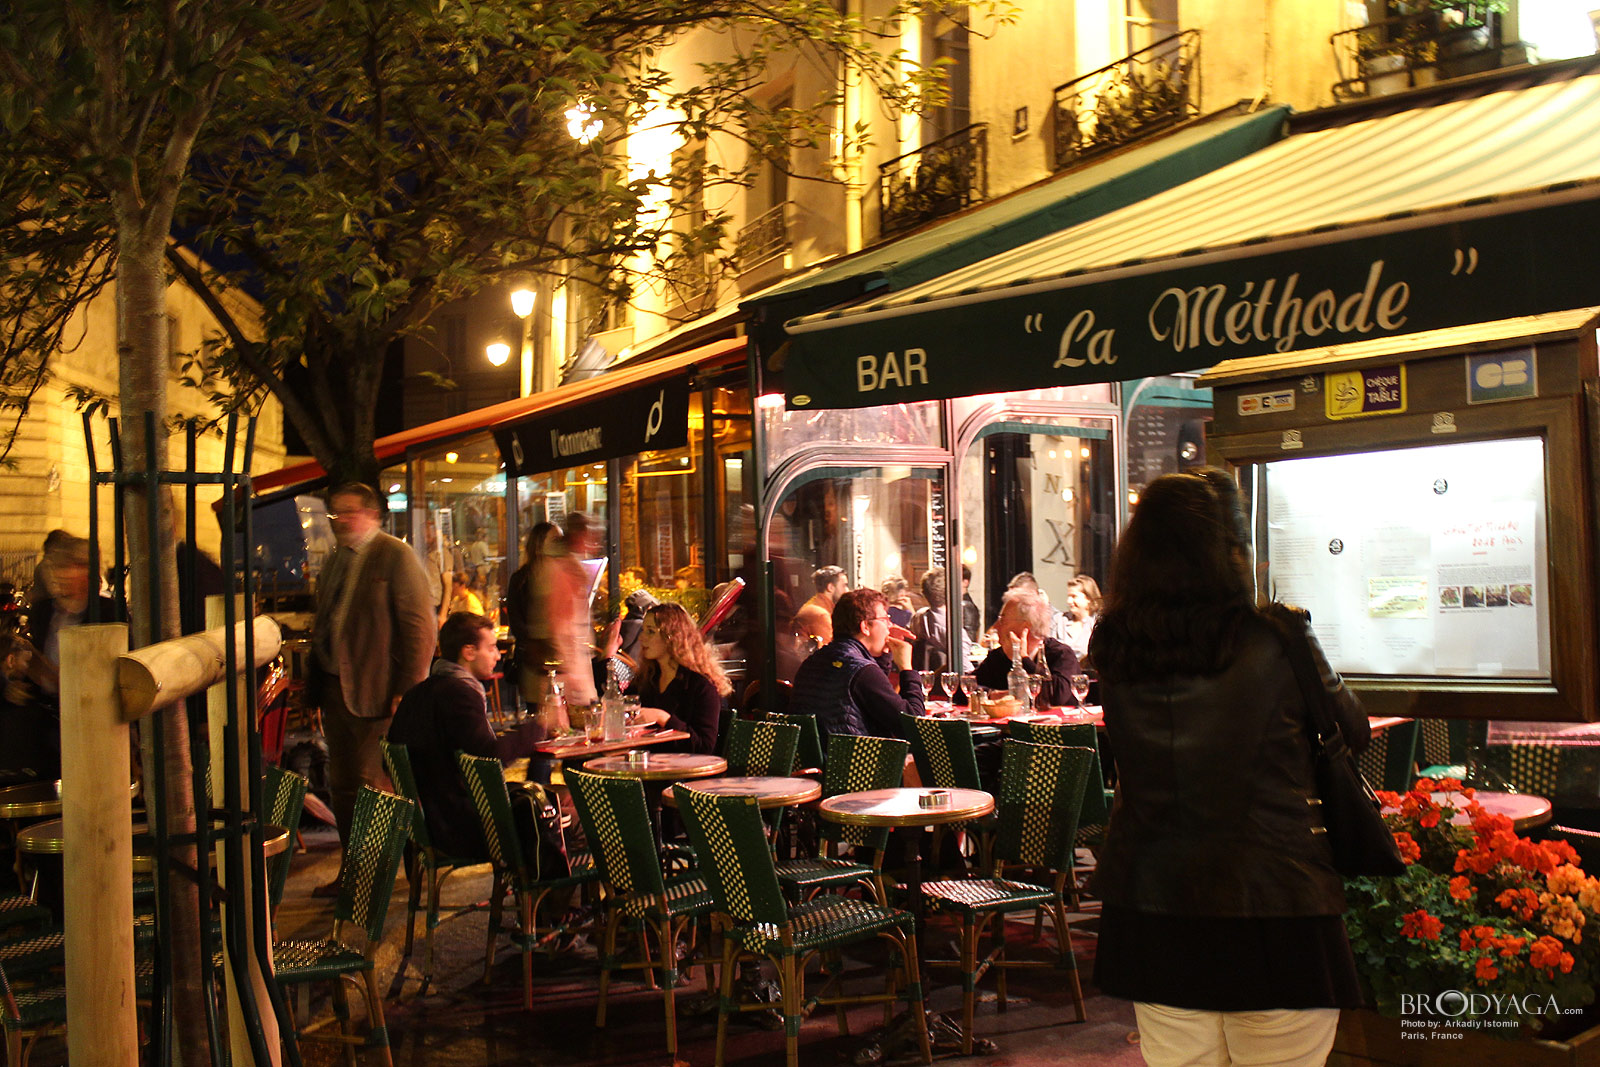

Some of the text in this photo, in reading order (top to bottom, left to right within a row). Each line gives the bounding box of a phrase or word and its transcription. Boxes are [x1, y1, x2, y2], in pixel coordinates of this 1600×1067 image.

[1053, 309, 1118, 369] La
[1148, 259, 1411, 353] Méthode
[857, 347, 929, 392] BAR
[1366, 389, 1399, 404] TABLE
